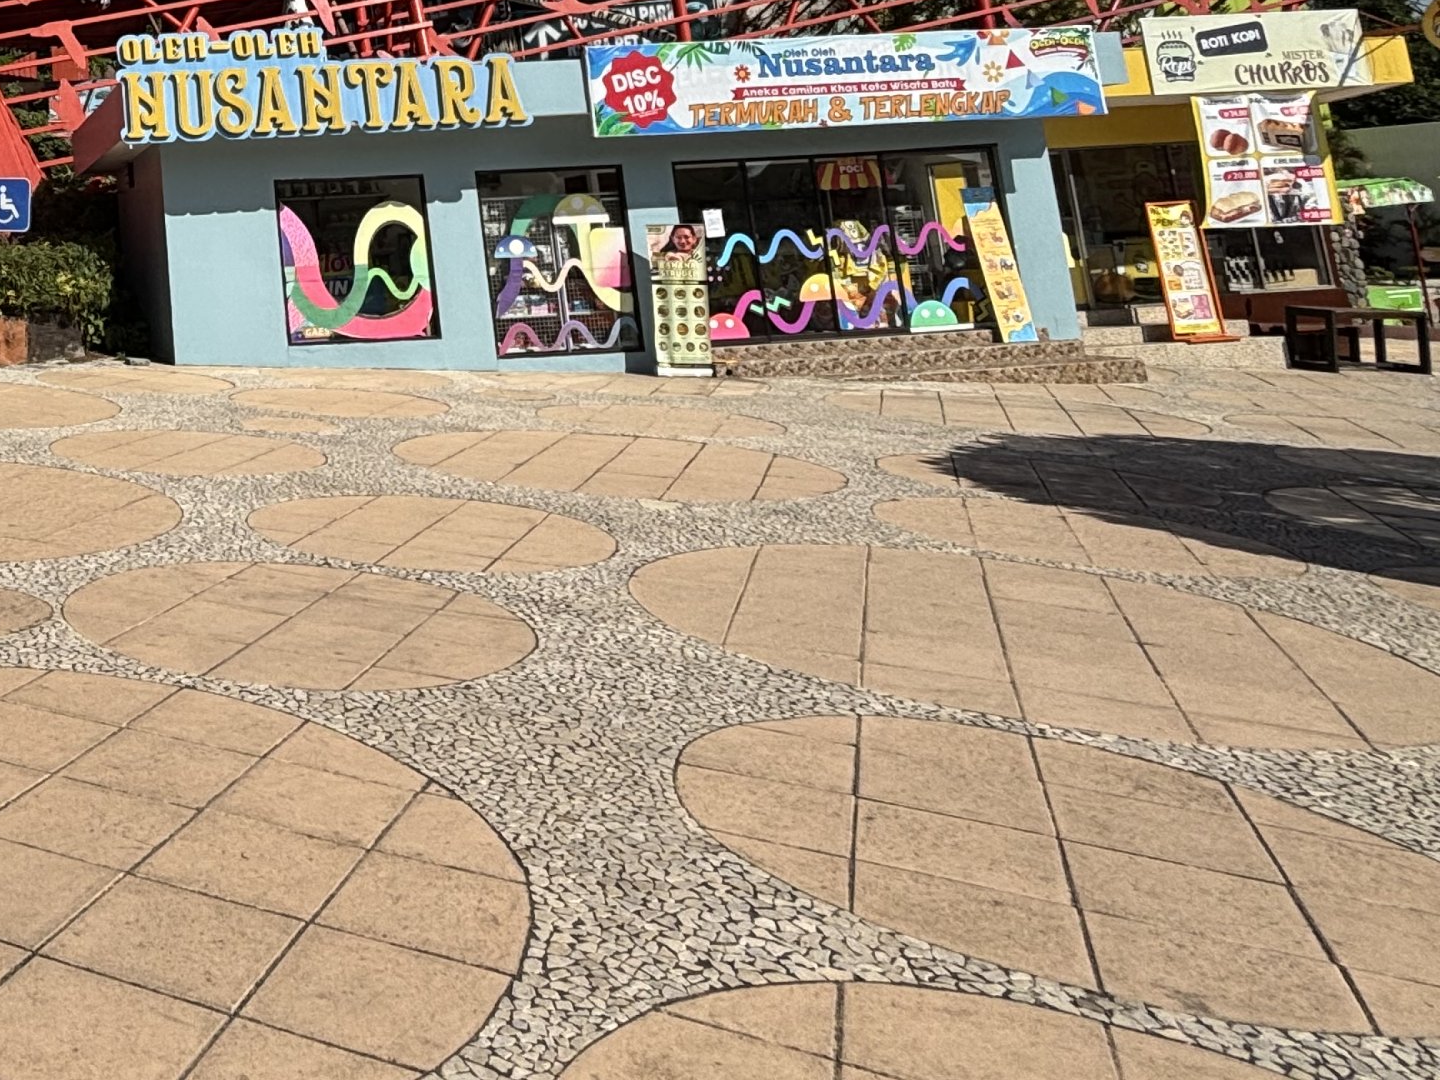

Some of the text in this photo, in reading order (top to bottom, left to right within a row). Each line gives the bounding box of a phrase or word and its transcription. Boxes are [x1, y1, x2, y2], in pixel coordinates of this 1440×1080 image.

[121, 30, 320, 62] OLEH-OLEH
[783, 47, 836, 59] Oleh Oleh
[1200, 29, 1261, 51] ROTI KOPI
[758, 50, 936, 79] Nusantara
[1282, 49, 1325, 61] MISTER
[611, 66, 661, 93] DISC
[1234, 60, 1330, 86] CHURROS
[121, 57, 528, 140] NUSANTARA
[623, 89, 665, 114] 10%
[742, 79, 958, 98] Aneka Camilan Khas Kota Wisata Batu
[688, 89, 1012, 129] TERMURAH & TERLENGKAP
